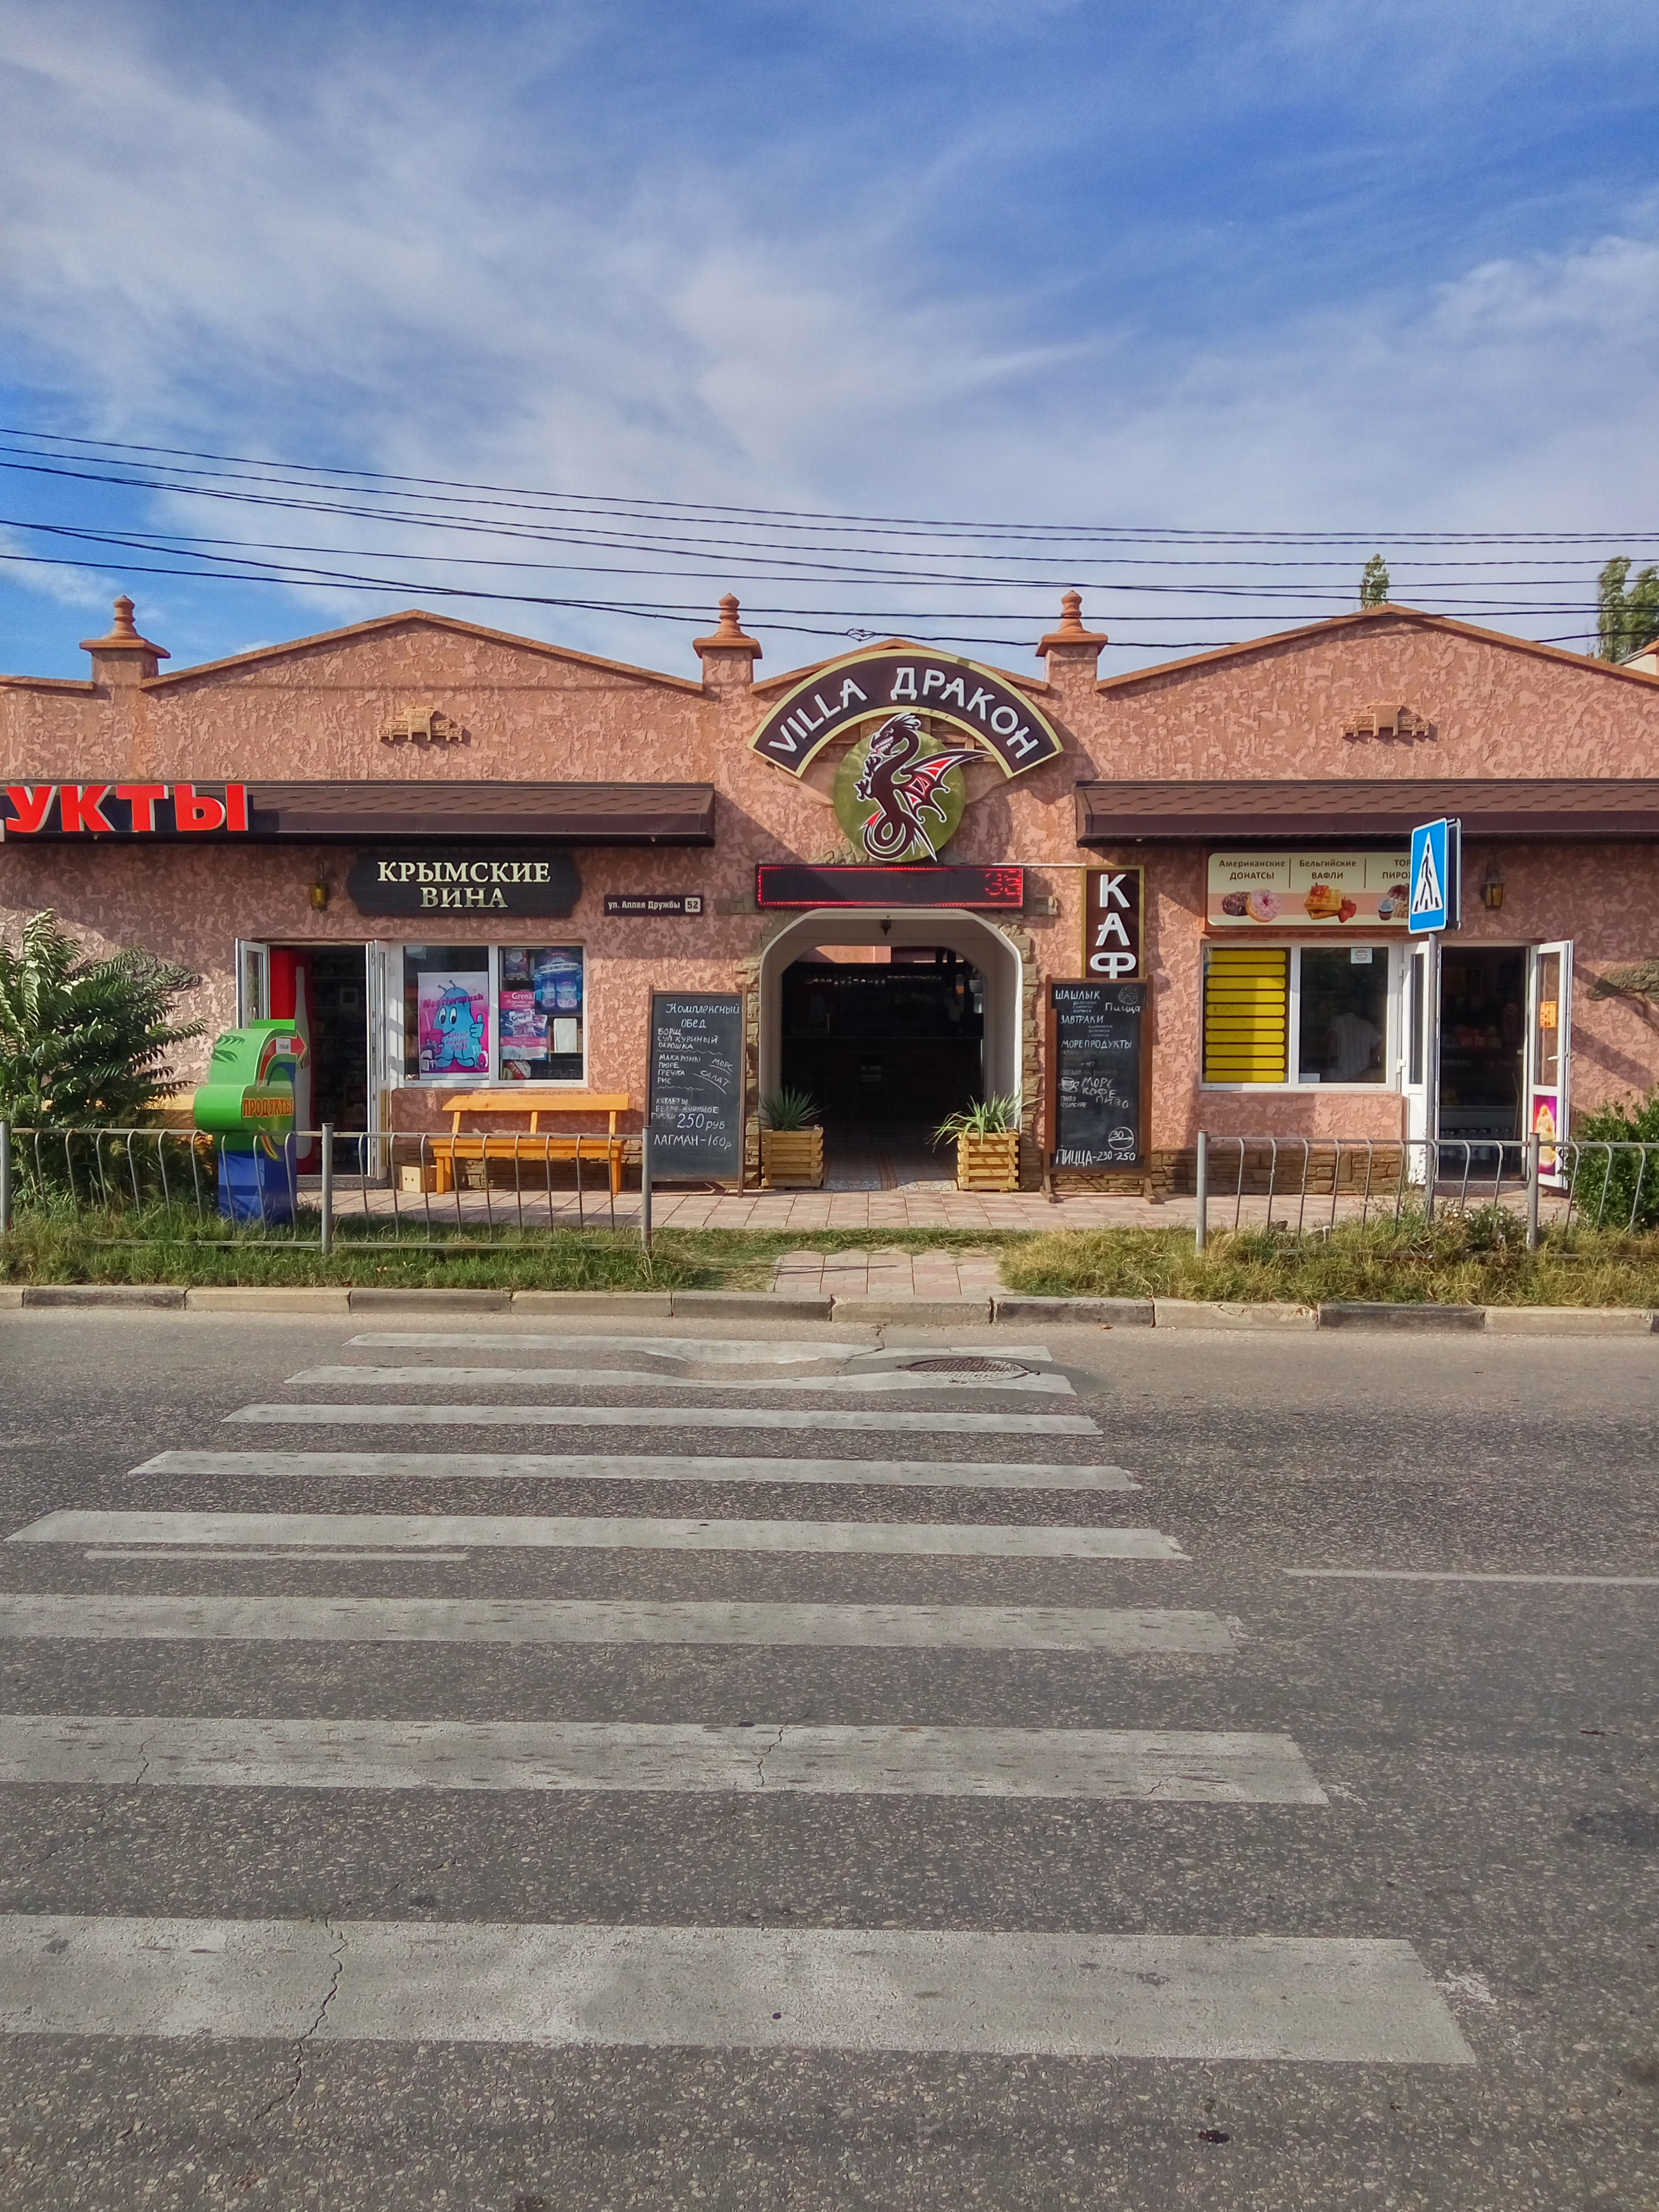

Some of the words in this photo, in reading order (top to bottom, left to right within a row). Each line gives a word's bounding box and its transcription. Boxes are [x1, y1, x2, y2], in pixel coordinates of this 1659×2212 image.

[768, 678, 868, 753] VILLA
[890, 667, 1040, 759] ДРАКОН
[0, 784, 248, 842] УКТЫ
[1219, 859, 1285, 868] Американские
[1300, 859, 1356, 868] Бельгийские
[377, 861, 551, 883] КРЫМСКИЕ
[1229, 872, 1274, 881] ДОНАТСЫ
[420, 887, 509, 908] ВИНА
[608, 901, 620, 910] ул.
[648, 901, 681, 910] Дружбы
[687, 901, 699, 909] 52
[1091, 874, 1137, 979] КАФ
[1055, 990, 1100, 1000] ШАШЛЫК
[665, 1003, 740, 1014] Комплексный
[1105, 1002, 1141, 1014] Пицца
[1060, 1015, 1104, 1024] ЗАВТРАКИ
[658, 1028, 681, 1036] БОРЩ
[675, 1035, 719, 1044] КУРИНЫЙ
[659, 1054, 701, 1062] МАКАРОНЫ
[711, 1058, 733, 1072] МОРС
[542, 1069, 581, 1078] ТКРЫТО
[700, 1070, 732, 1086] САЛАТ
[1081, 1077, 1114, 1088] МОРС
[1082, 1087, 1118, 1099] КОФЕ
[242, 1098, 294, 1118] ПРОДУКТЫ
[1096, 1096, 1129, 1109] ПИВО
[677, 1113, 705, 1128] 250
